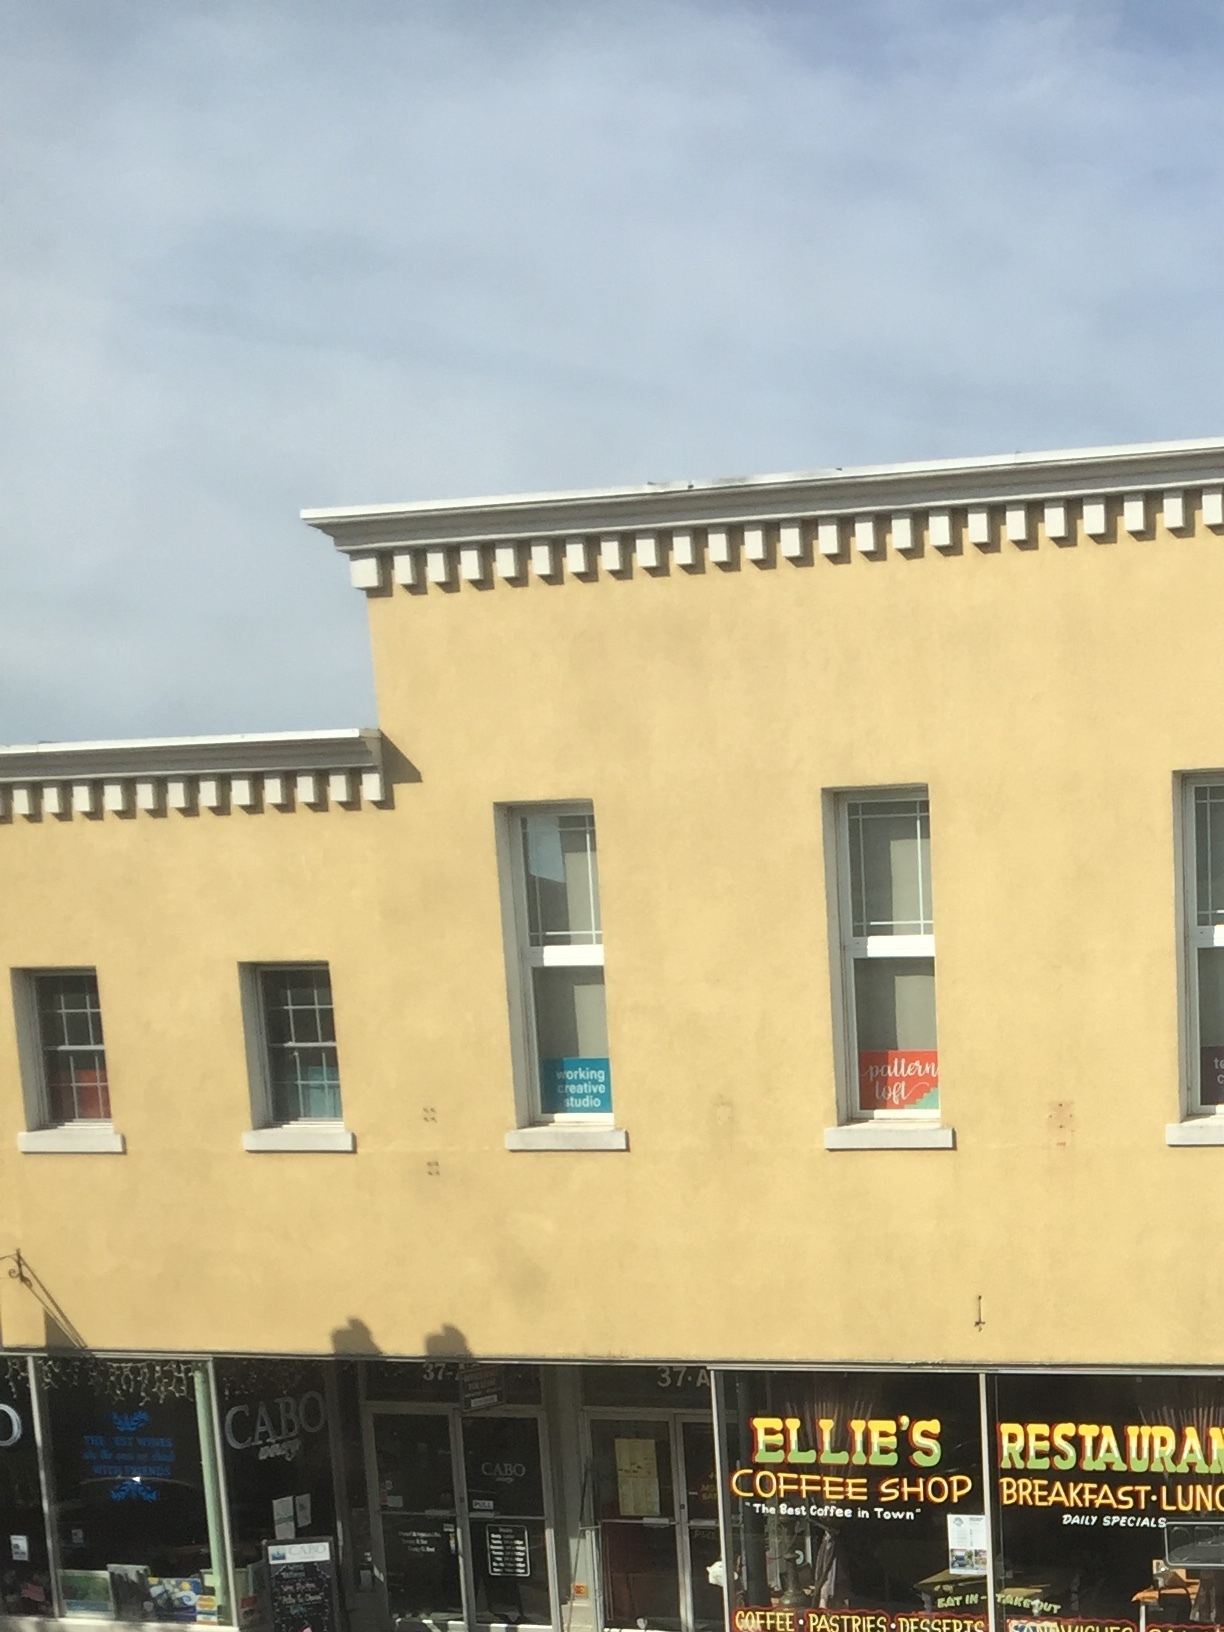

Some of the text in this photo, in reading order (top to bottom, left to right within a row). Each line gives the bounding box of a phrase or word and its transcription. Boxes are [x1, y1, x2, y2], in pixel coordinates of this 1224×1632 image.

[555, 1067, 605, 1082] working
[557, 1082, 606, 1094] creative
[875, 1081, 929, 1105] loft
[564, 1095, 602, 1108] studio
[224, 1390, 326, 1450] CABO
[750, 1414, 942, 1467] ELLIE'S
[481, 1462, 526, 1477] CABO
[731, 1469, 973, 1504] COFFEE SHOP
[998, 1477, 1151, 1511] BREAKFAST
[779, 1504, 806, 1516] Best
[810, 1504, 853, 1518] Coffee
[857, 1505, 870, 1518] in
[1062, 1514, 1167, 1528] DAILY SPECIALS
[288, 1543, 327, 1556] CABO
[937, 1596, 962, 1609] EAT
[965, 1593, 979, 1605] IN
[996, 1593, 1030, 1610] TAKE
[1036, 1601, 1061, 1614] OUT
[734, 1609, 795, 1632] COFFEE
